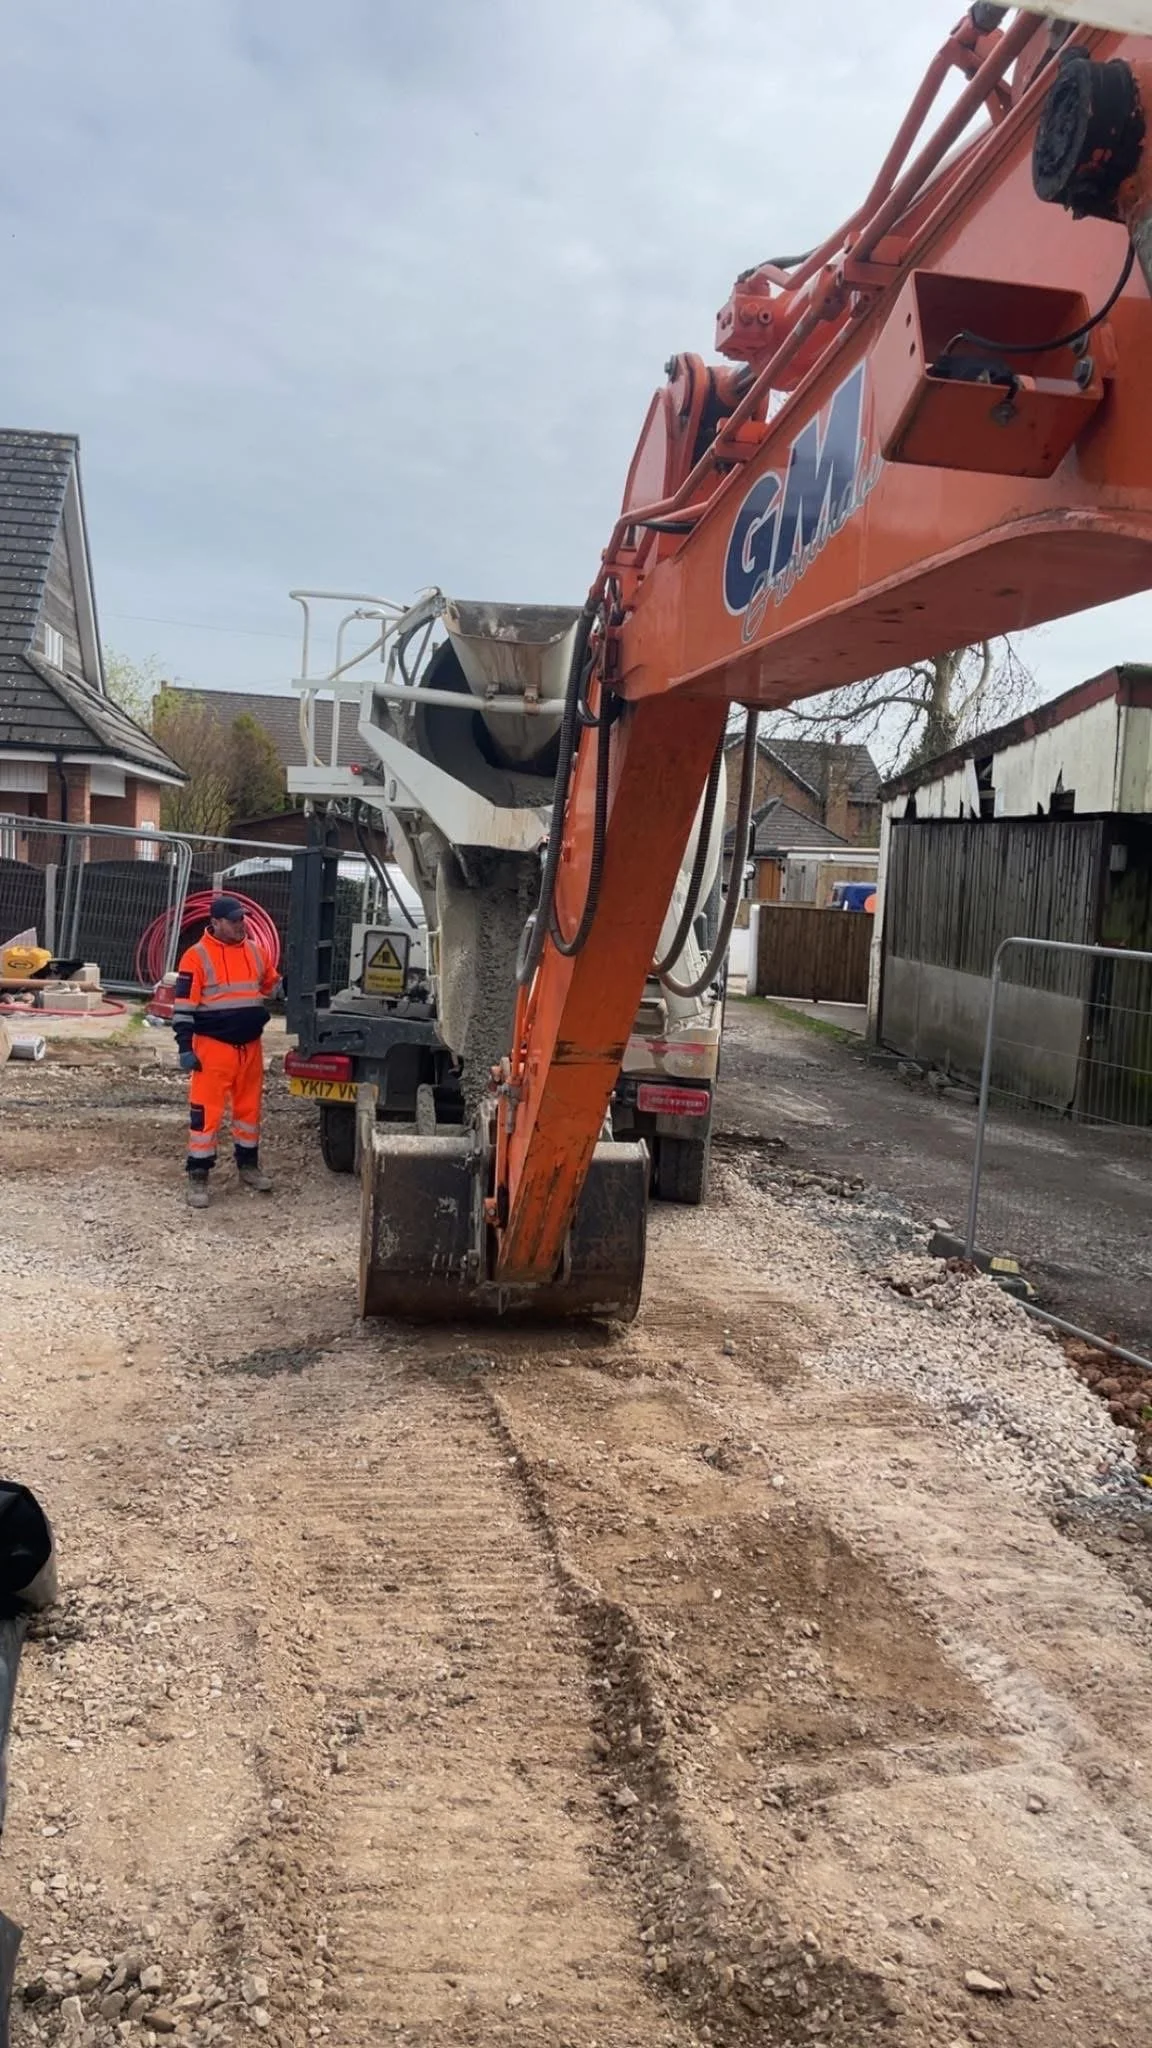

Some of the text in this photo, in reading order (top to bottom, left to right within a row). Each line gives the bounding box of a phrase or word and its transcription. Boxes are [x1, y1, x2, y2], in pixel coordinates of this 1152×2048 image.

[724, 356, 867, 617] GM
[300, 1079, 359, 1101] YK17 VN
